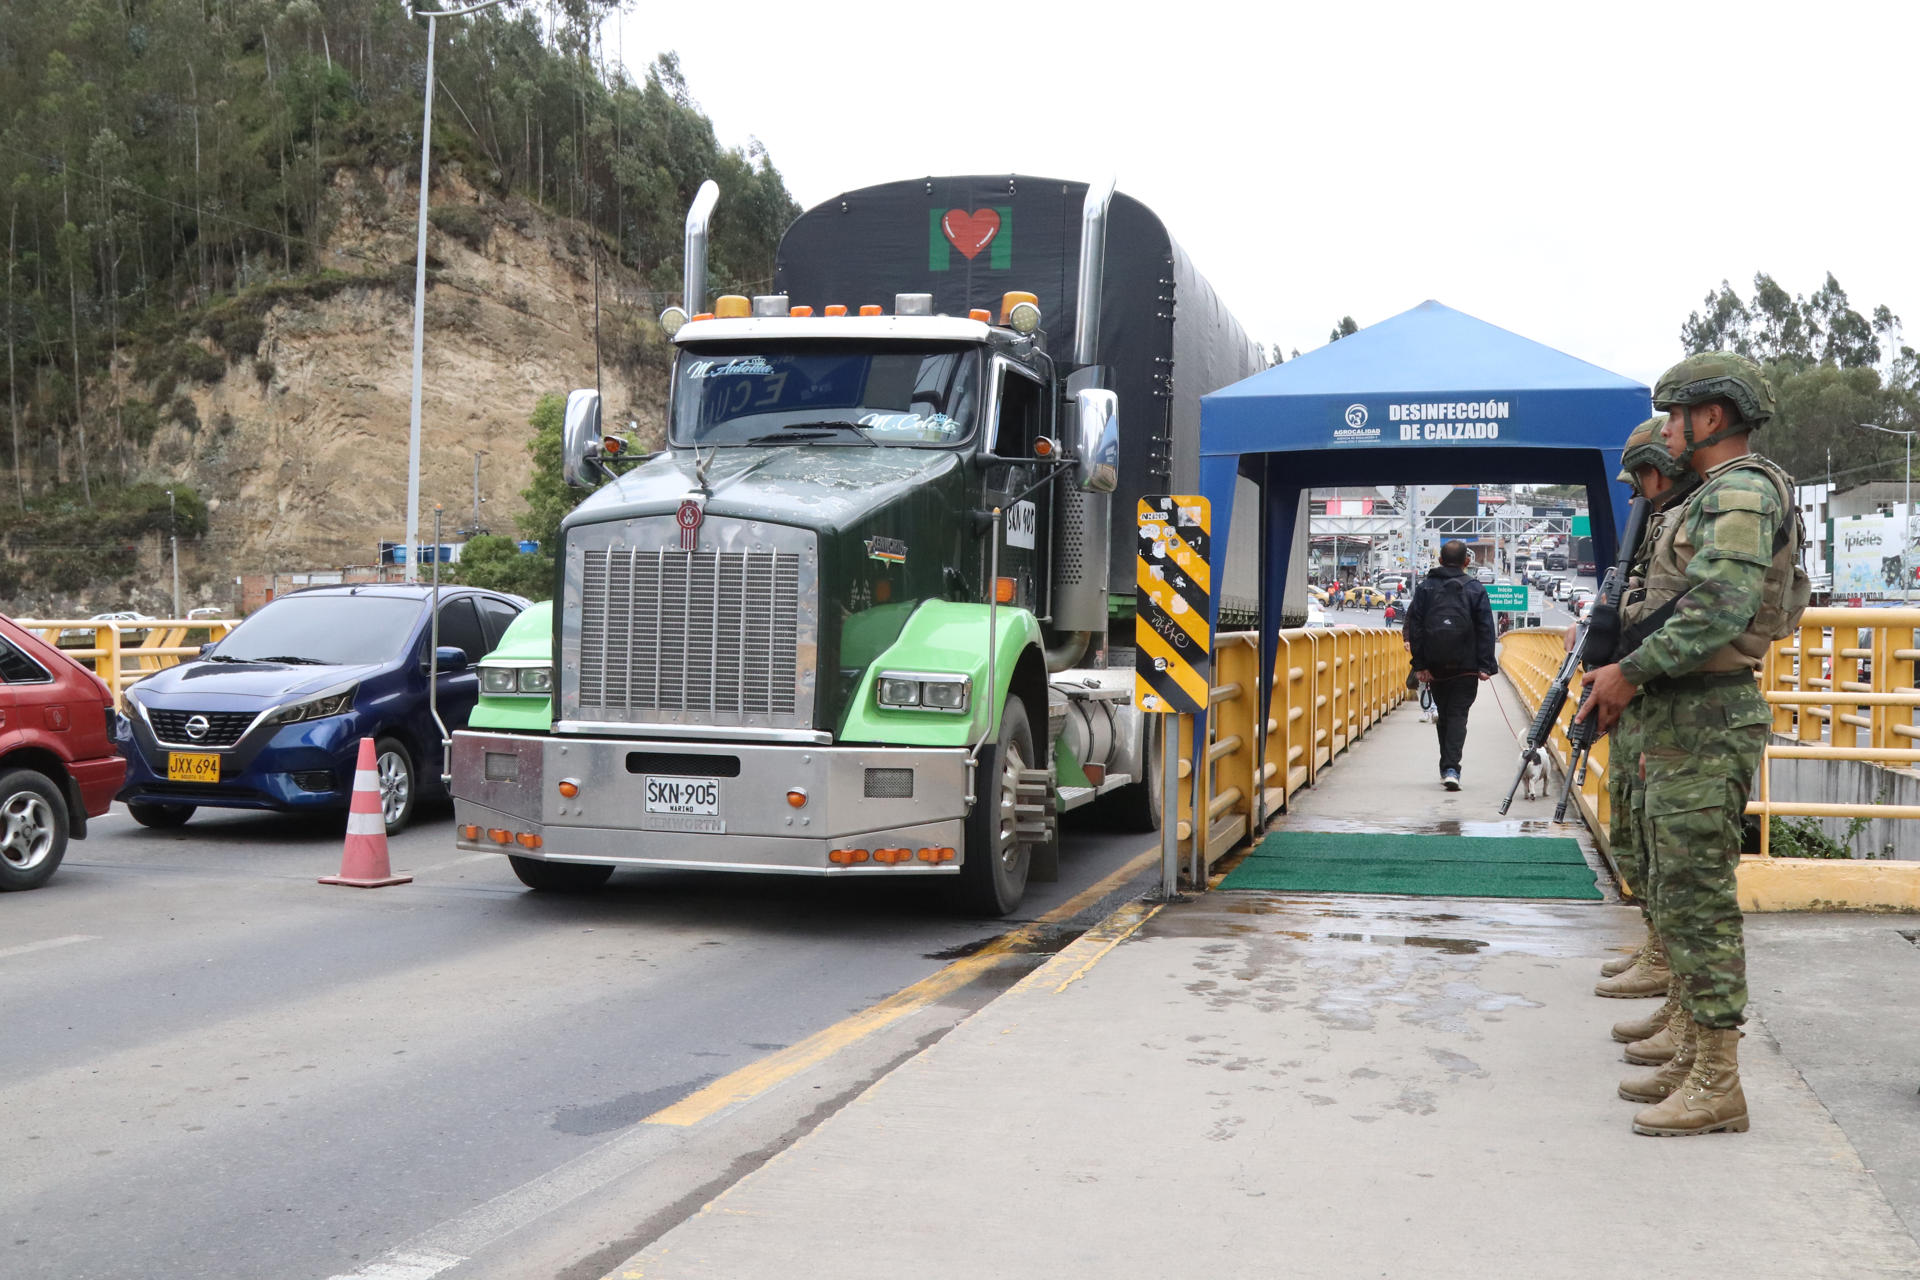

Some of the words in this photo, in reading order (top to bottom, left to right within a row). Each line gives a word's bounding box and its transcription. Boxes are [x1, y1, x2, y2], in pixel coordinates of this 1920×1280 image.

[1389, 399, 1509, 421] DESINFECCIÓN
[1334, 428, 1381, 436] AGROCALIDAD
[1399, 424, 1420, 441] DE
[1424, 422, 1499, 440] CALZADO
[1008, 504, 1021, 531] SKN
[1023, 507, 1034, 535] 905
[647, 817, 720, 831] KENWORTH
